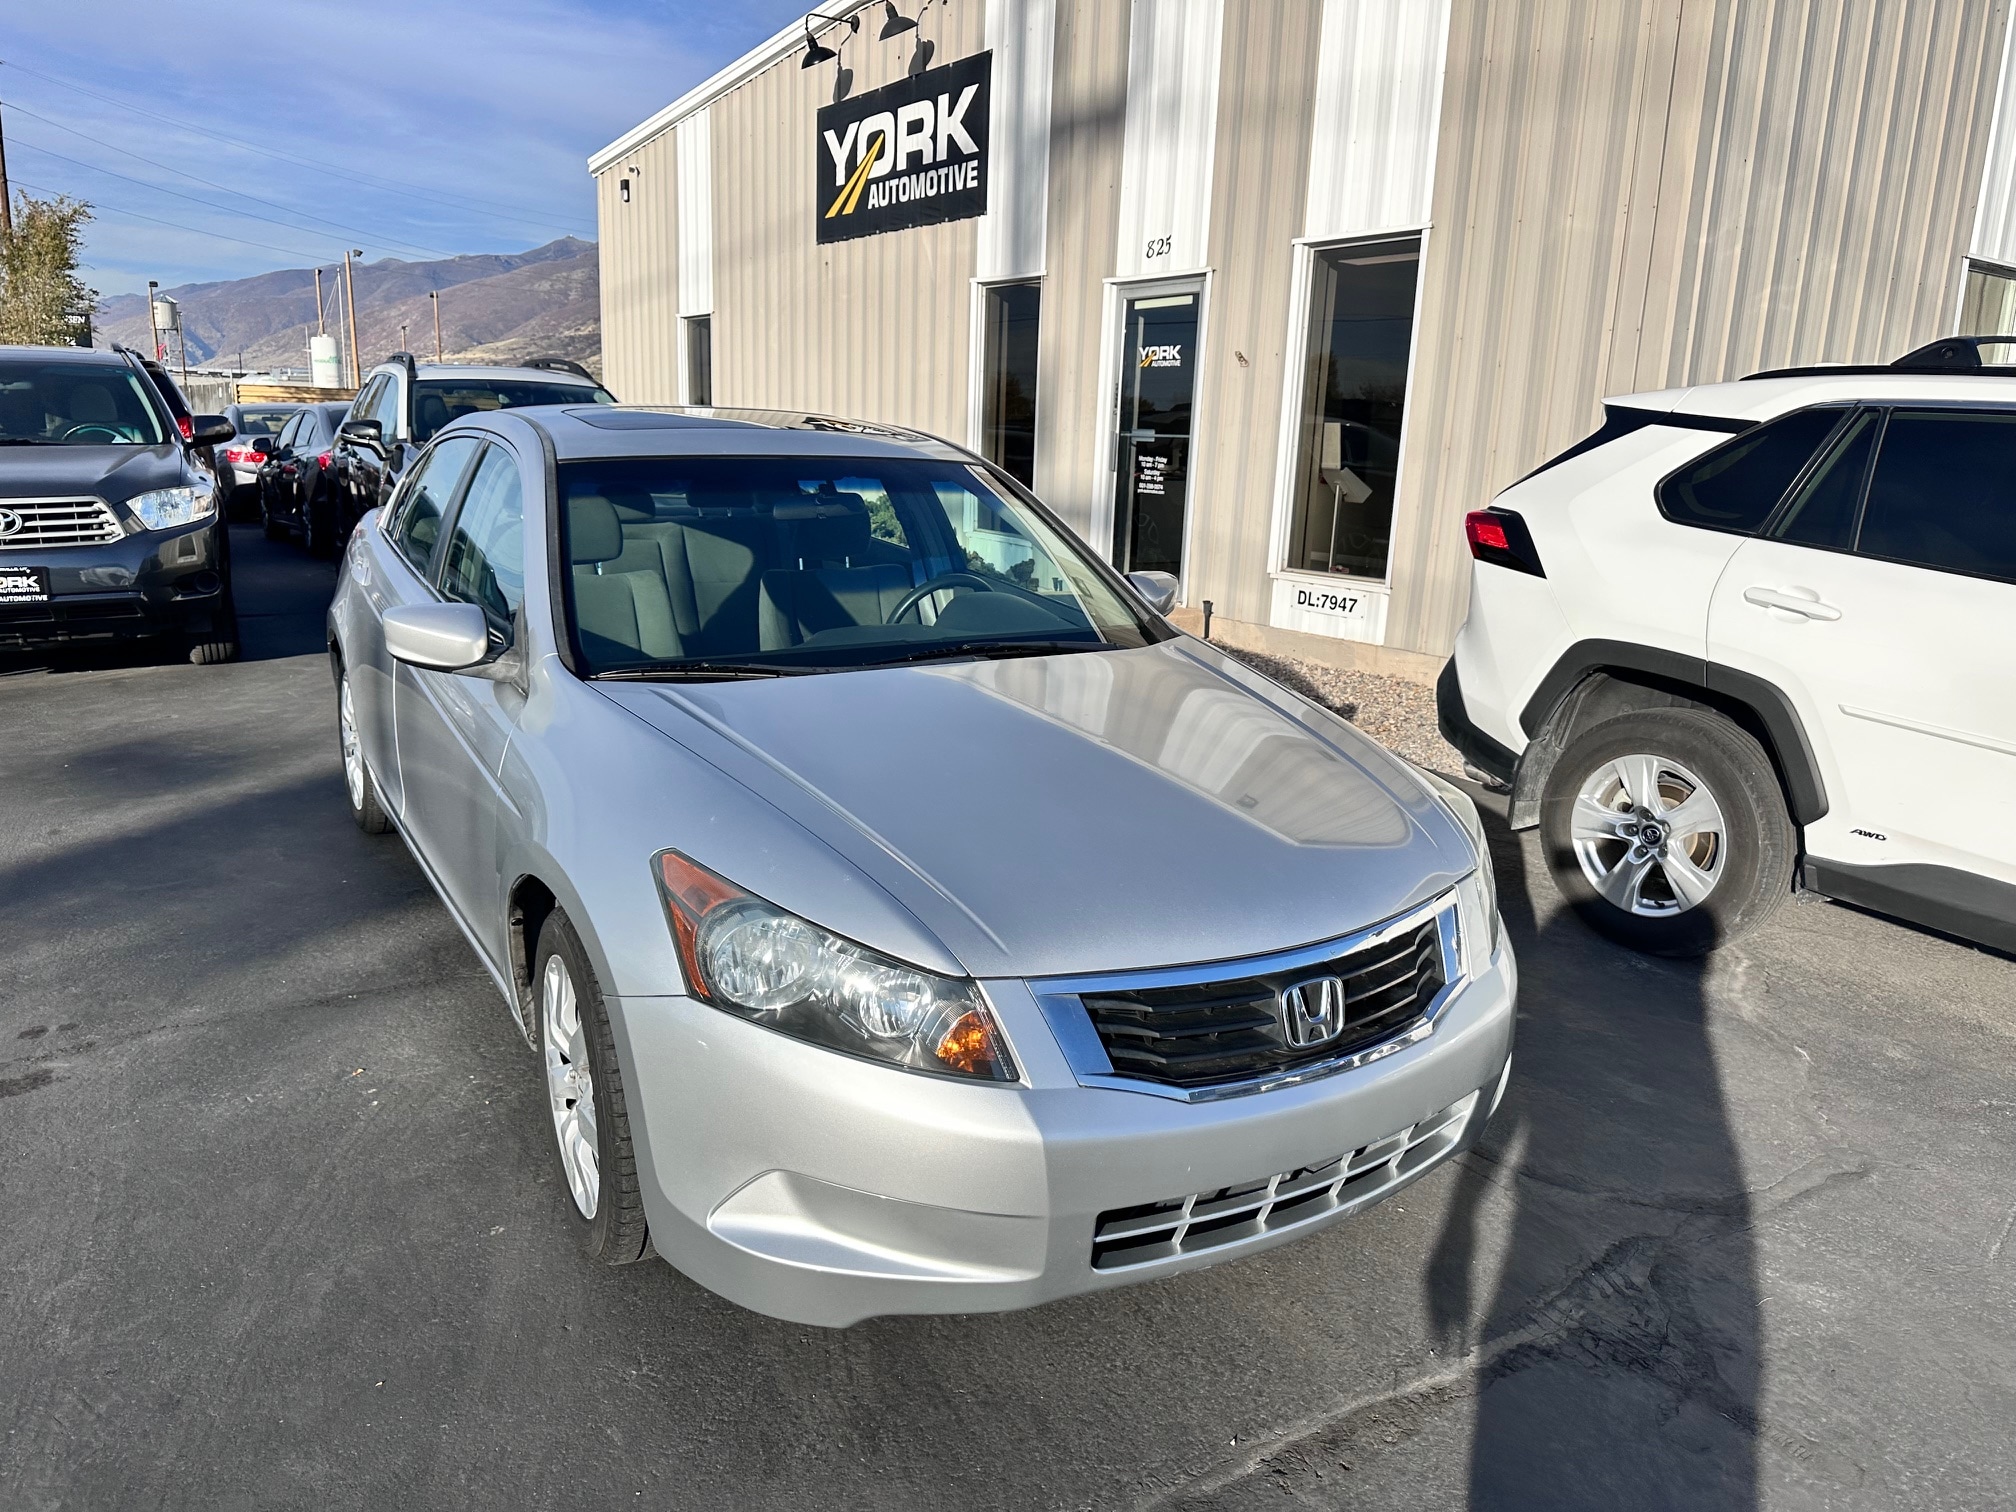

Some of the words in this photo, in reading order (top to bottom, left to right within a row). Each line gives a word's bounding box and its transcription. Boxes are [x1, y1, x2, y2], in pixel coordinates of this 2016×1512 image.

[823, 83, 979, 186] YORK
[867, 159, 979, 210] AUTOMOTIVE
[1146, 234, 1172, 259] 825
[1139, 345, 1181, 360] YORK
[1297, 590, 1358, 613] DL:7947
[1849, 828, 1887, 841] AWD
